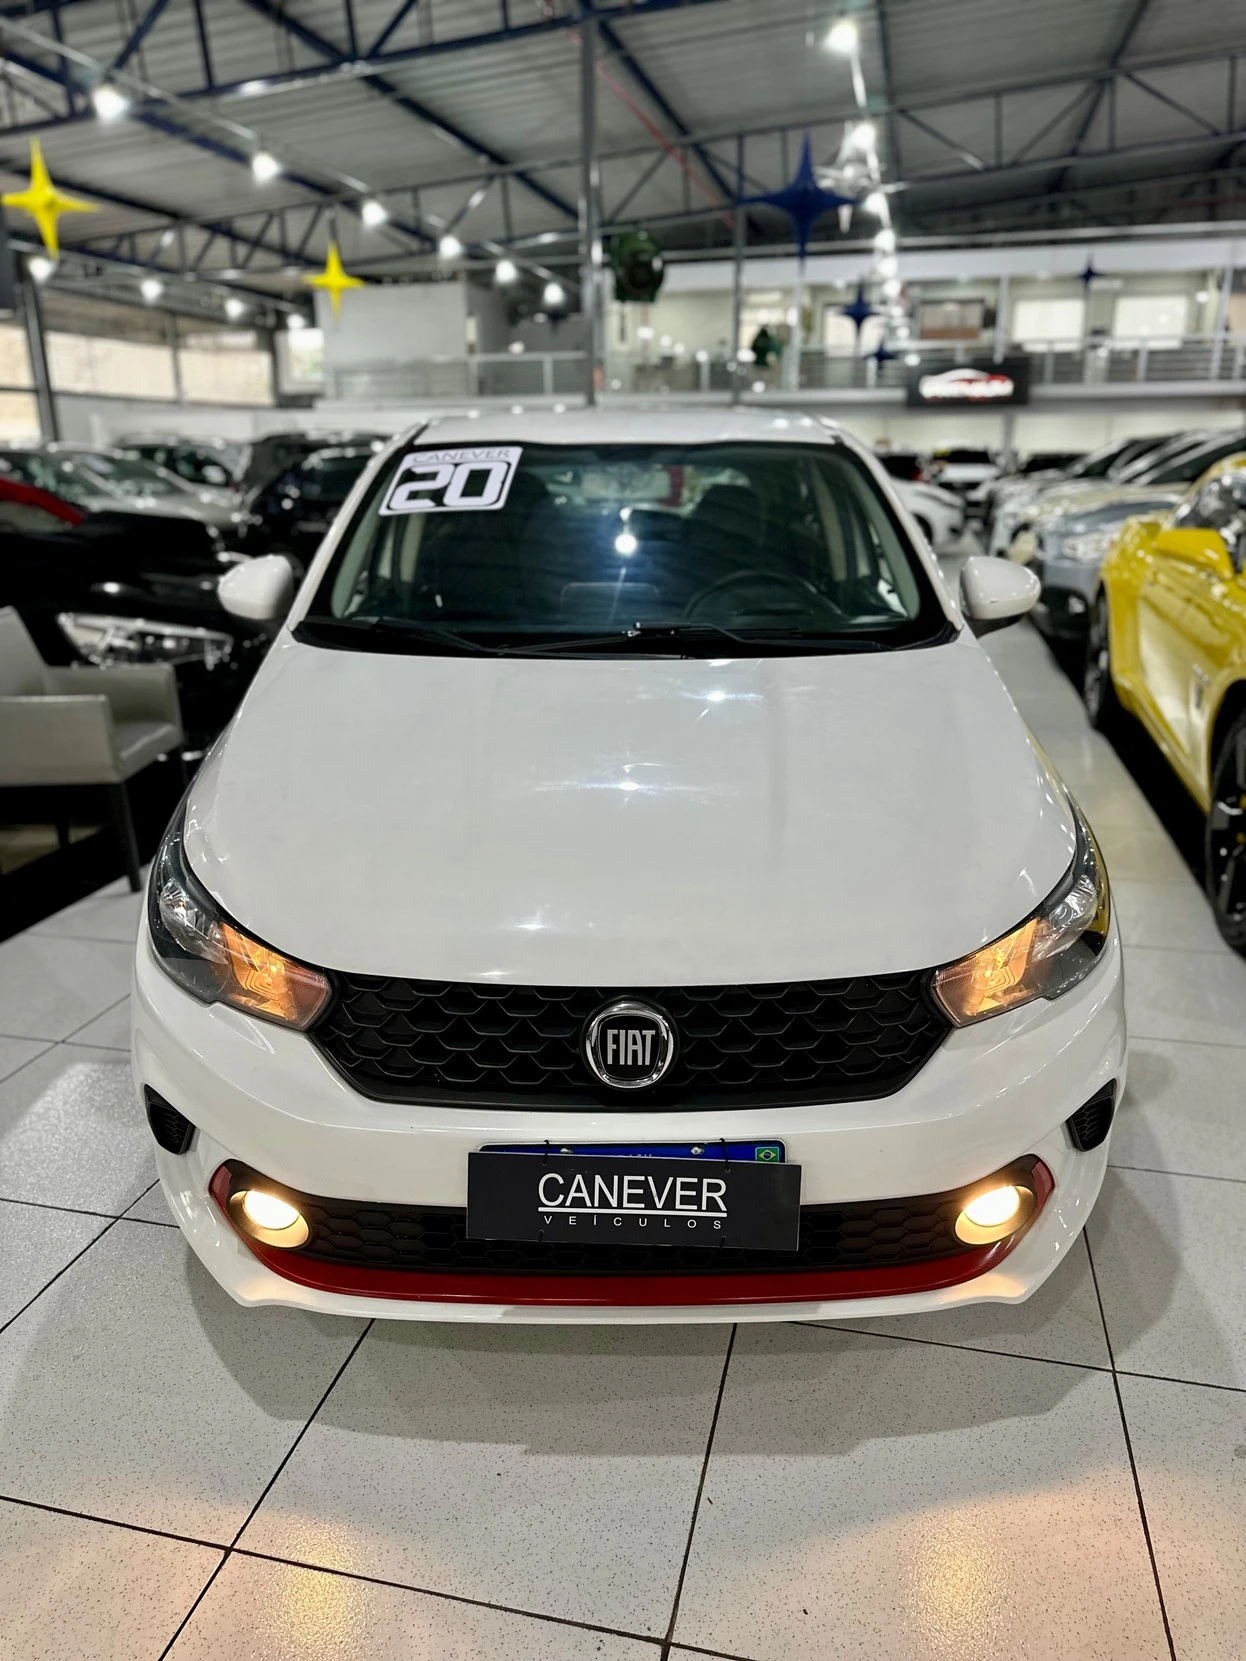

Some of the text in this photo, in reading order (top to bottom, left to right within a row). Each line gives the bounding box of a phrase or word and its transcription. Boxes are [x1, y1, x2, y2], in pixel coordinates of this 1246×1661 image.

[413, 448, 511, 463] CANEVER
[388, 463, 510, 511] 20
[607, 1029, 656, 1065] FIAT
[538, 1173, 727, 1212] CANEVER
